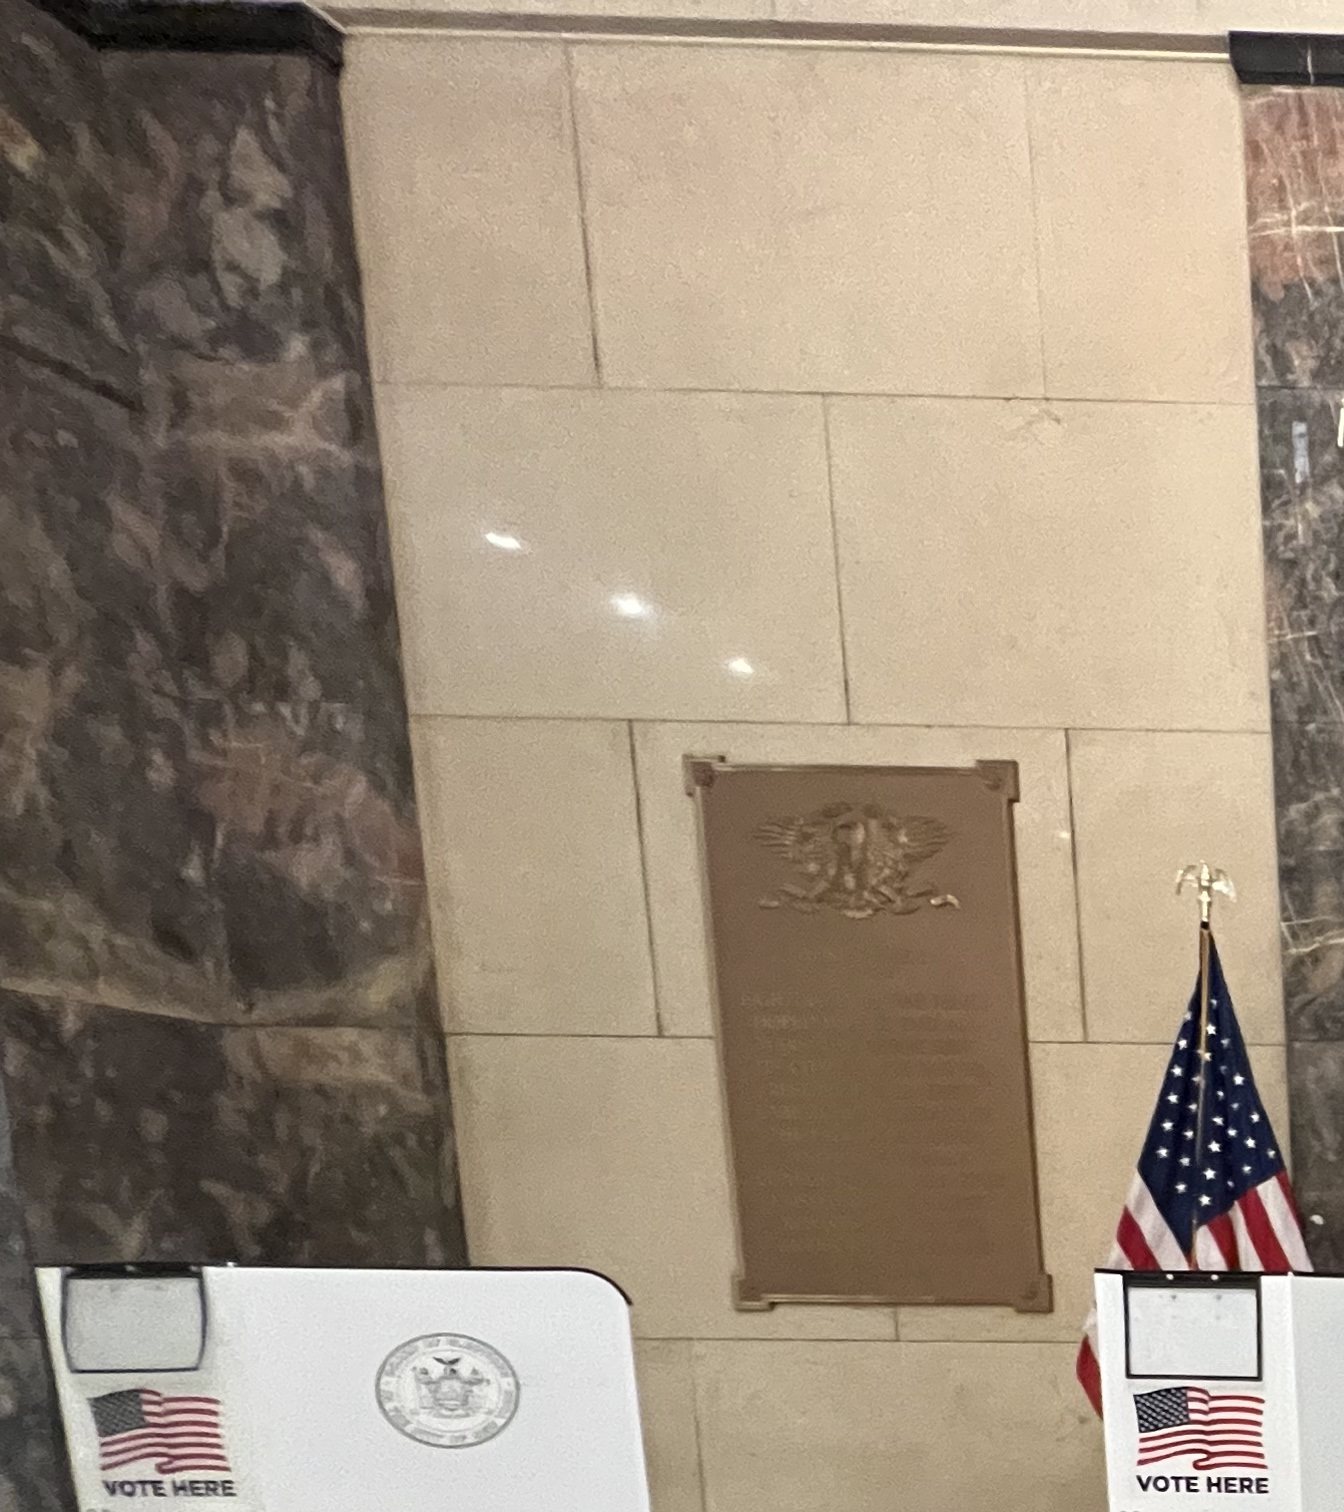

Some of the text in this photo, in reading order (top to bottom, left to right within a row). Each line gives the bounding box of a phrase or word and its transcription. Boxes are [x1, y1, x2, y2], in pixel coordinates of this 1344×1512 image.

[101, 1479, 237, 1497] VOTE HERE
[1136, 1474, 1269, 1494] VOTE HERE
